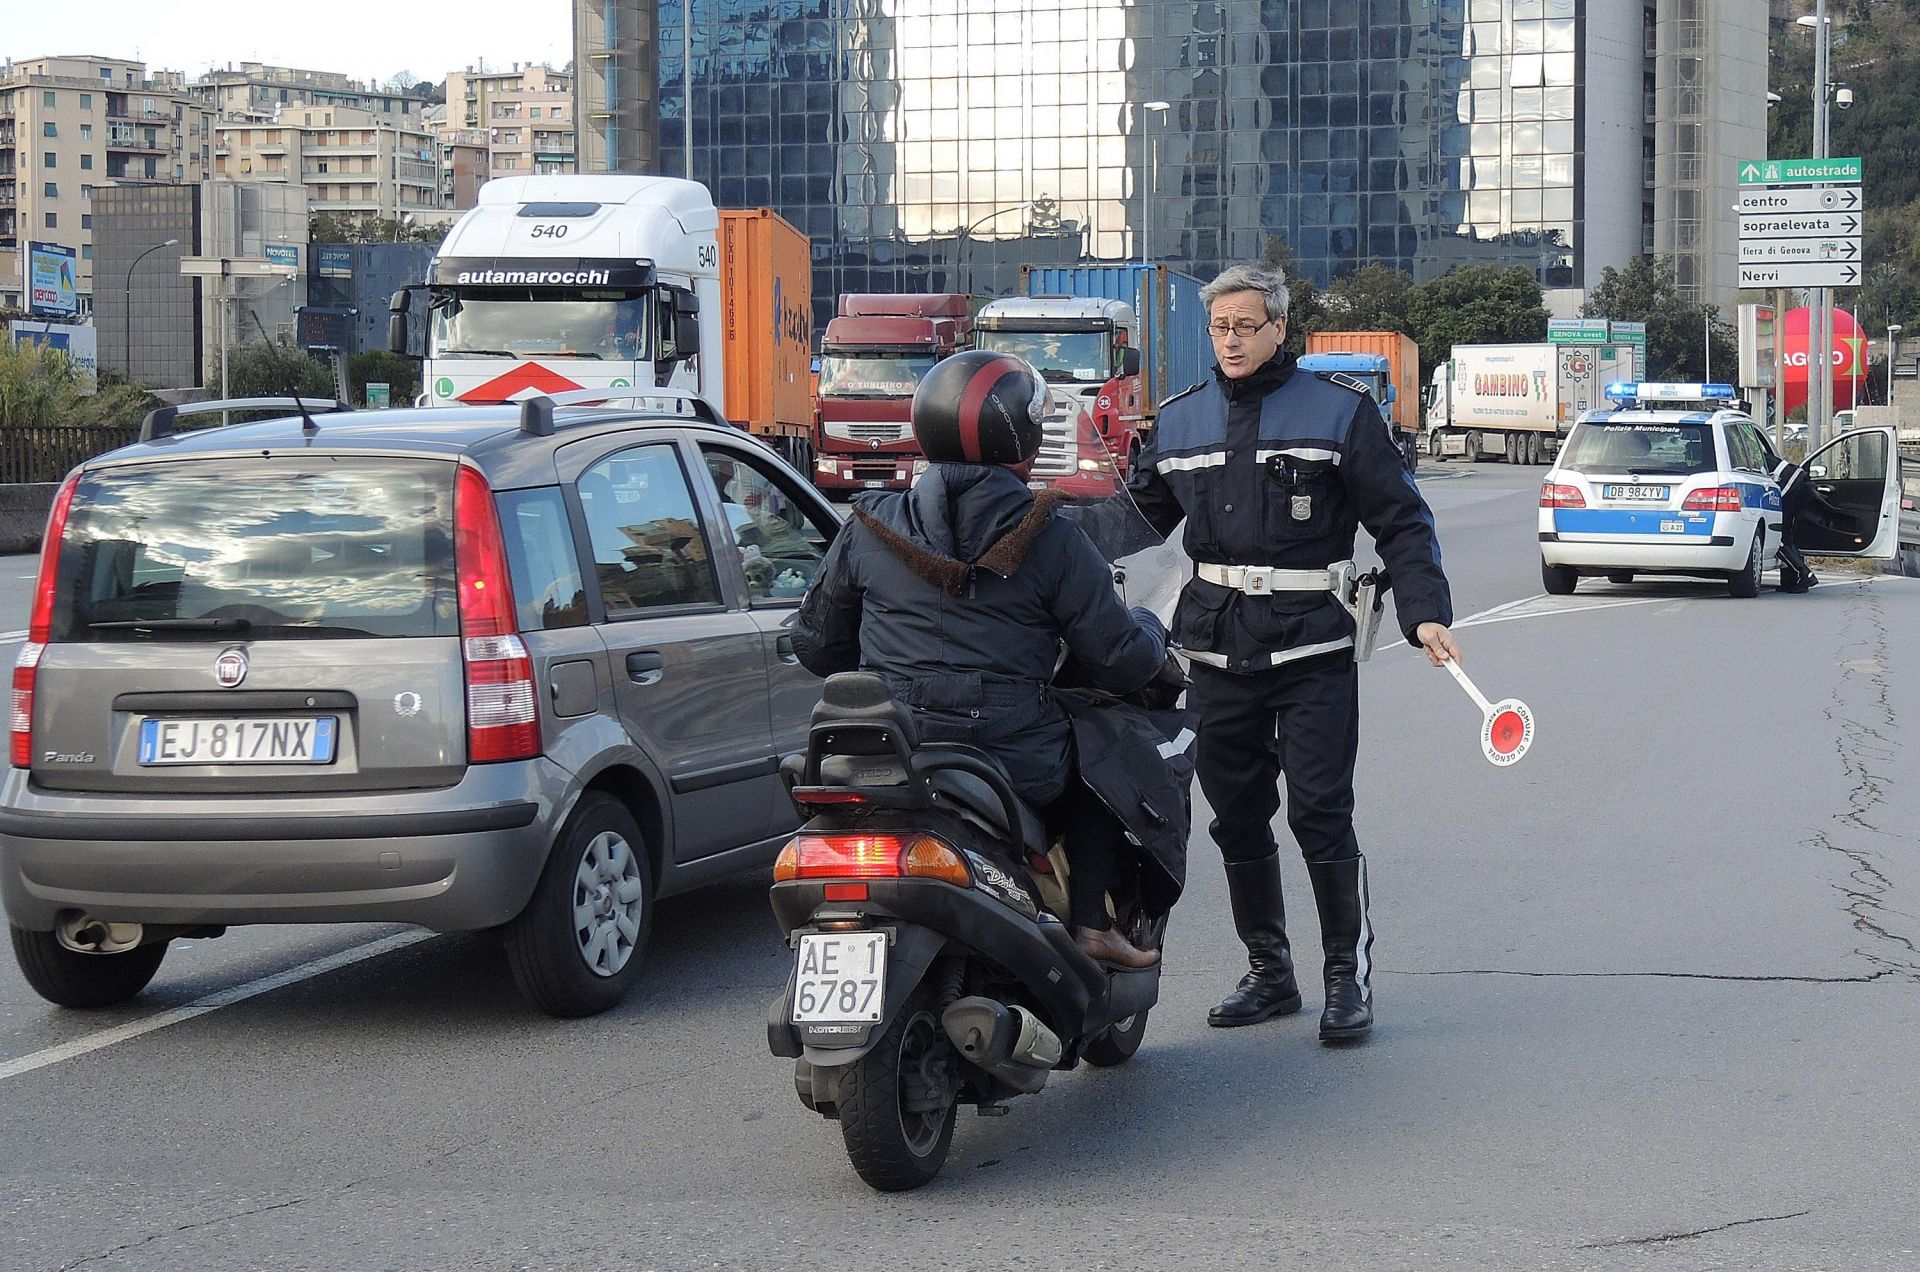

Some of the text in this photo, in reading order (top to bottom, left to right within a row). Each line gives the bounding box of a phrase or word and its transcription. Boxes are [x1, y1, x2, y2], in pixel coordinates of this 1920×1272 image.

[1786, 164, 1858, 177] autostrade
[1743, 196, 1788, 207] centro
[530, 225, 568, 238] 540
[1743, 218, 1830, 233] sopraelevata
[698, 245, 717, 268] 540
[1743, 245, 1811, 256] fiera di Genova
[457, 269, 610, 285] autamarocchi
[1742, 269, 1779, 281] Nervi
[439, 381, 449, 395] L
[858, 381, 903, 389] TUNISINO
[1475, 373, 1529, 397] GAMBINO
[1610, 487, 1625, 497] DB
[1488, 706, 1531, 763] COMUNE DI GENOVA
[43, 751, 96, 764] Panda
[801, 940, 876, 975] AE 1
[798, 979, 878, 1014] 6787
